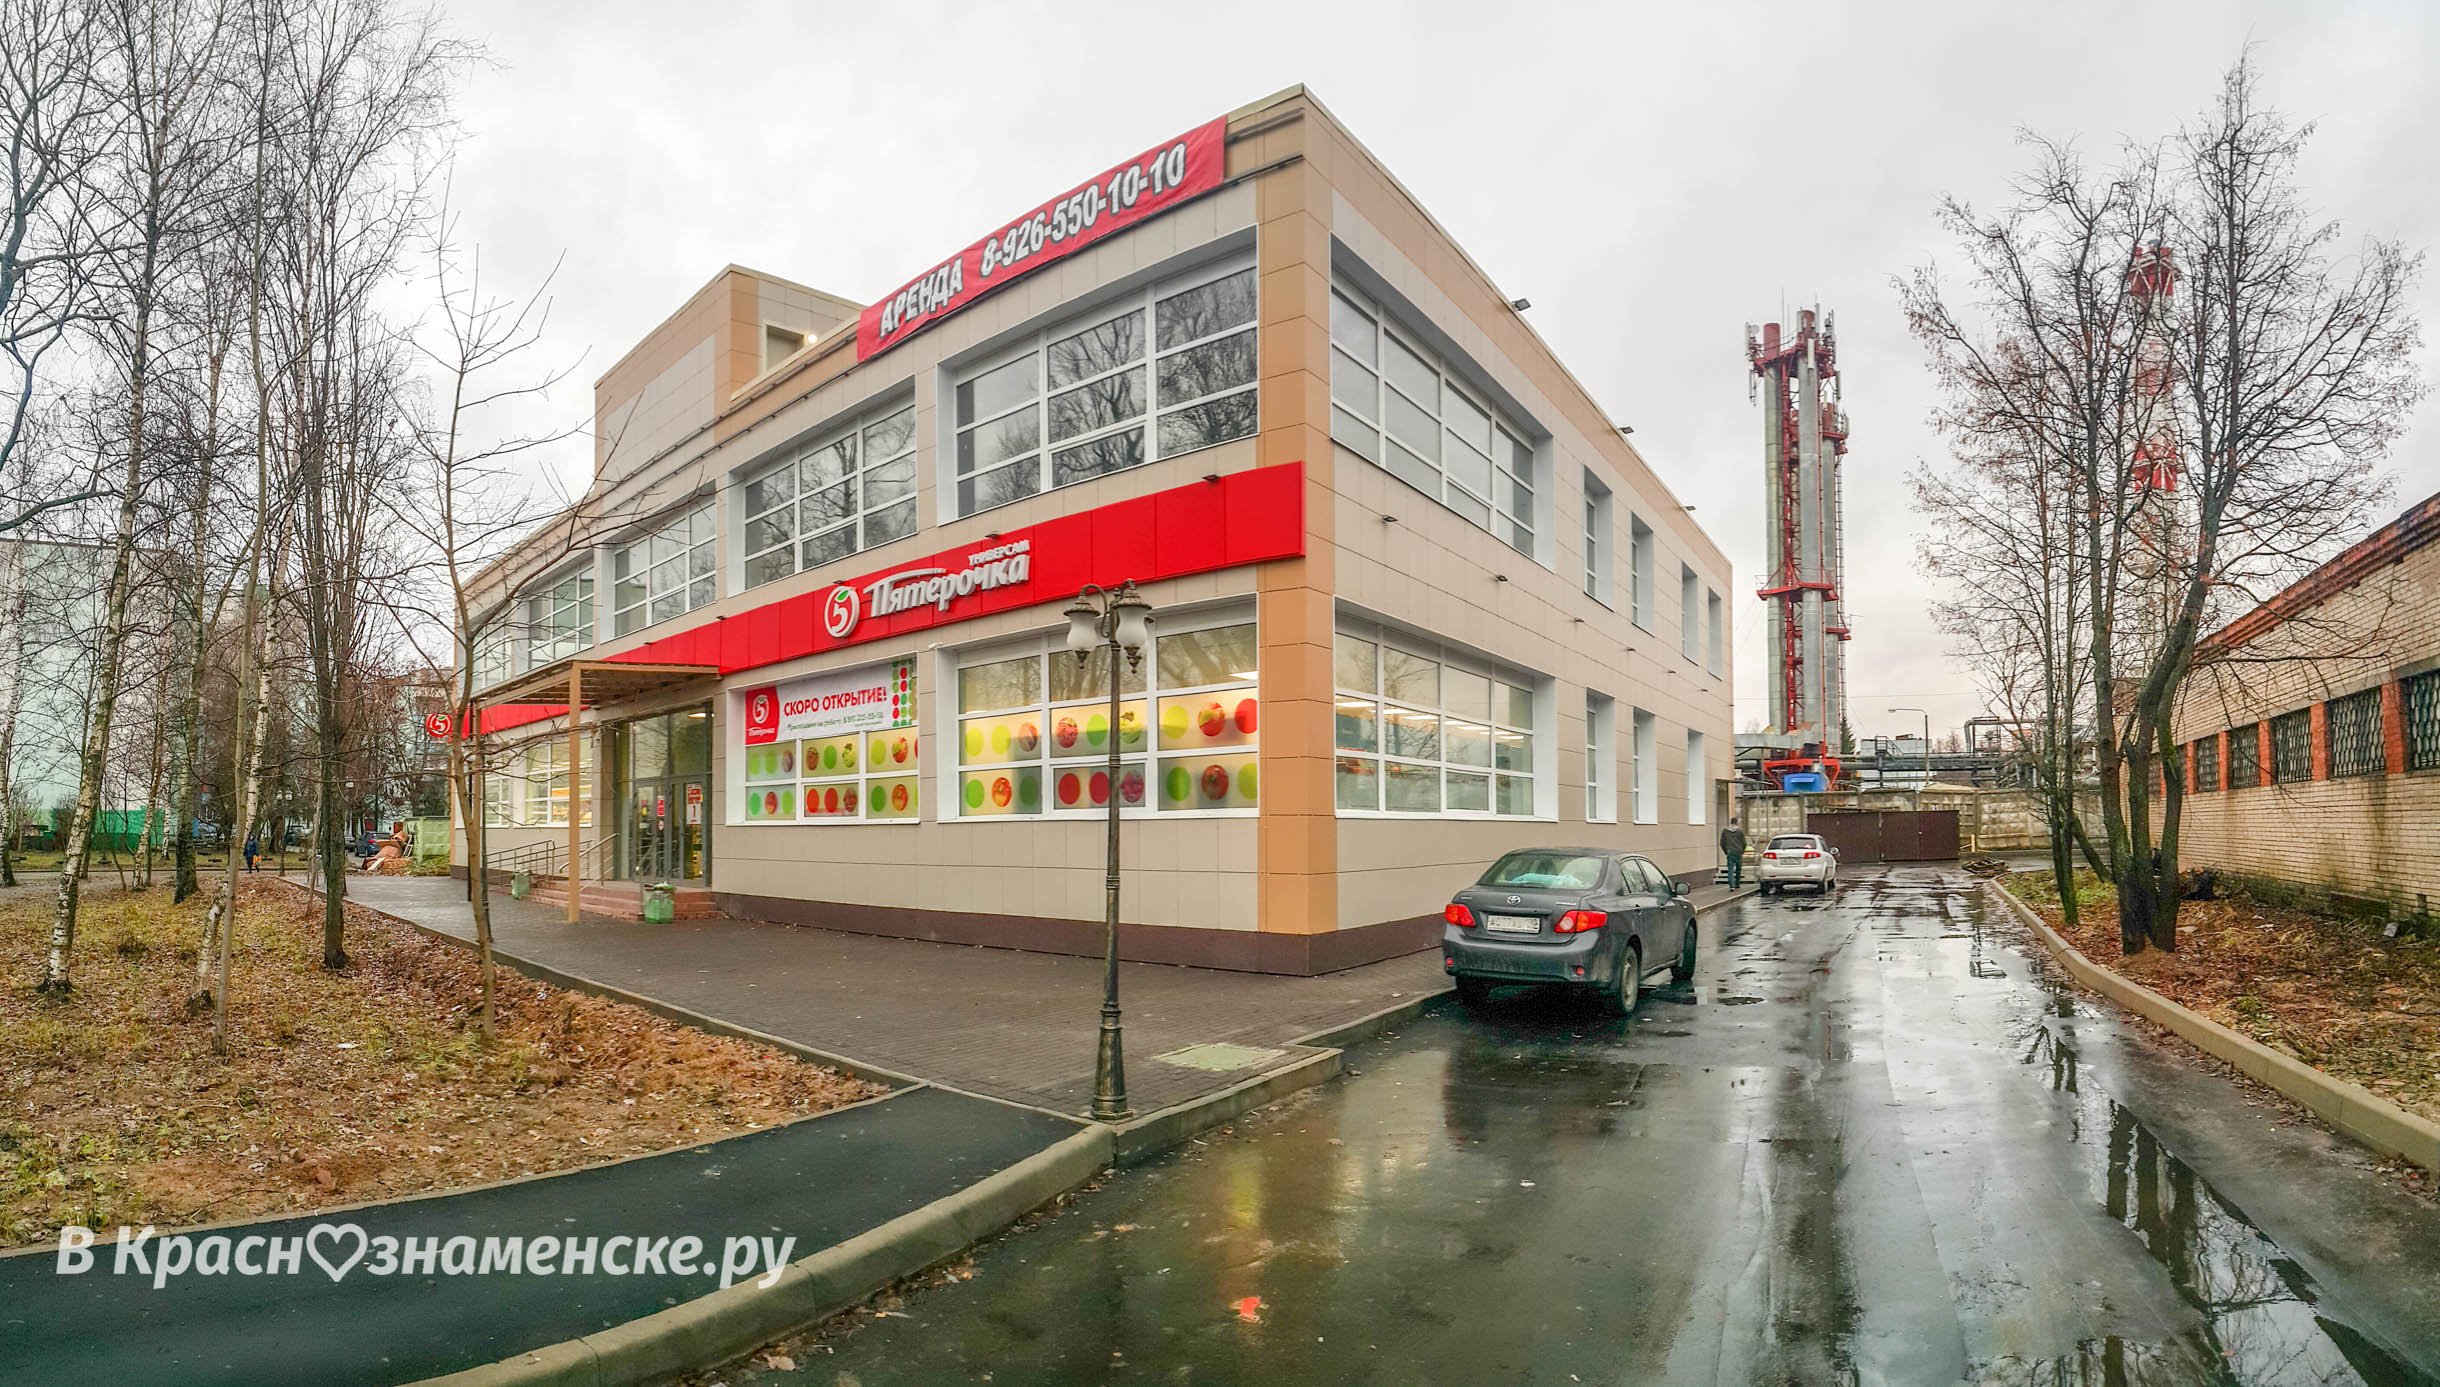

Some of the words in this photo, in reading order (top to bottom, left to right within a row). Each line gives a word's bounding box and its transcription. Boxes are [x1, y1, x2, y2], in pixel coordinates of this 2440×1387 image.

[879, 257, 964, 340] АРЕНДА
[980, 142, 1187, 278] 8-926-550-10-10
[968, 539, 1030, 567] УНИВЕРСАМ
[863, 553, 1030, 617] Пятерочка
[784, 698, 819, 717] СКОРО
[822, 686, 887, 711] ОТКРЫТИЕ!
